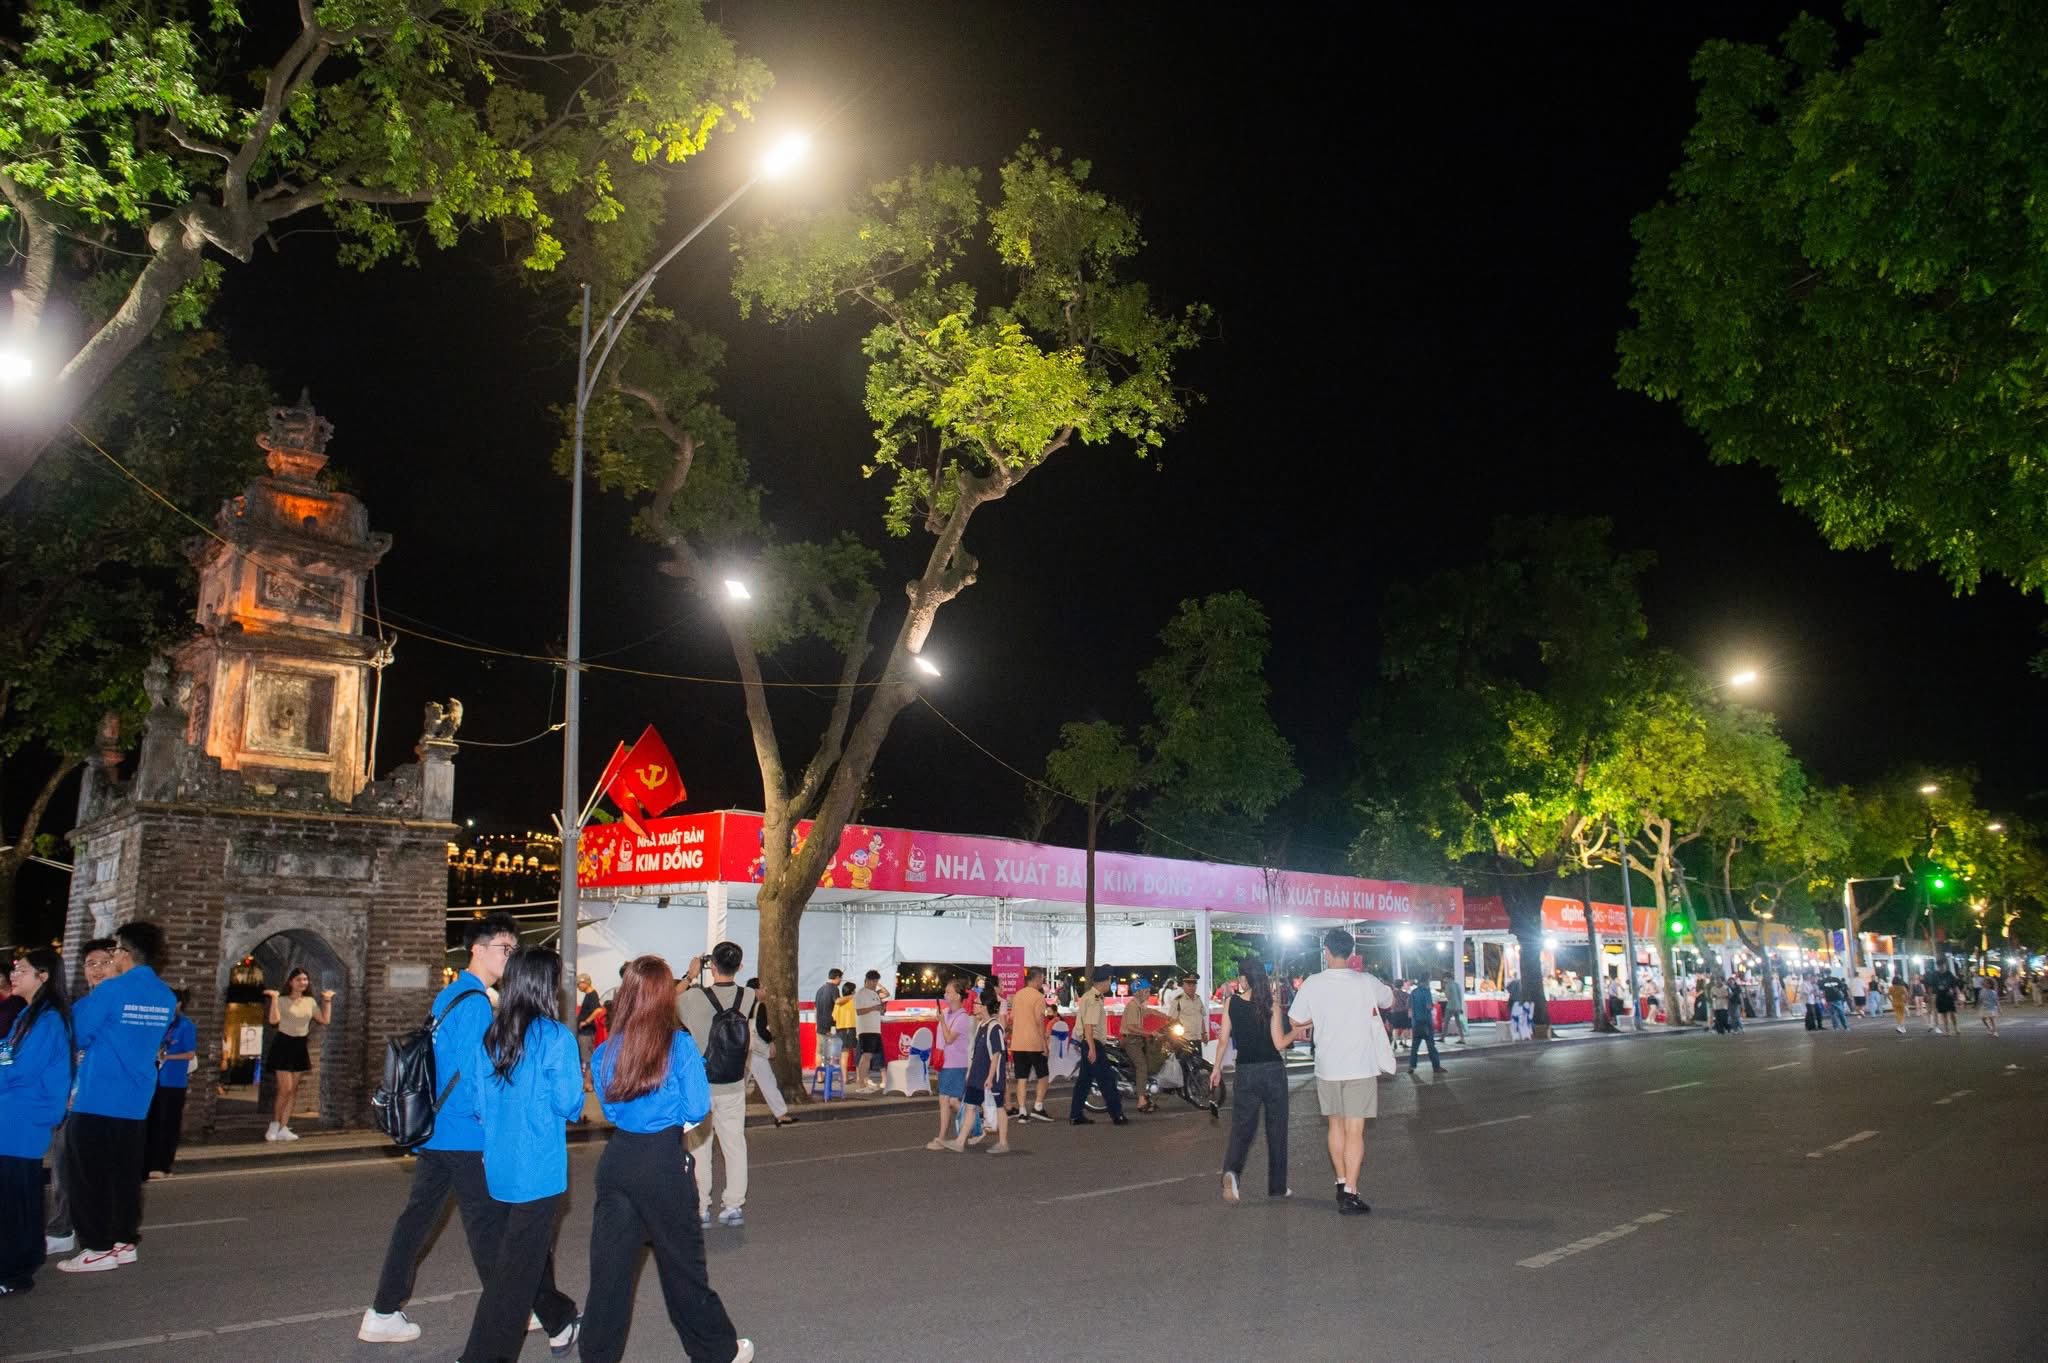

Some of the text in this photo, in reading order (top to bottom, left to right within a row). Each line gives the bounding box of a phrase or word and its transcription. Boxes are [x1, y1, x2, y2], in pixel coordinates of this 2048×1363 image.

[658, 827, 683, 846] XUẤT
[683, 826, 704, 844] BẢN
[635, 853, 660, 872] KIM
[662, 845, 704, 871] ĐỒNG
[935, 850, 986, 881] NHÀ
[993, 856, 1050, 886] XUẤT
[1103, 869, 1137, 893] KIM
[1324, 885, 1350, 909] BẢN
[1353, 891, 1375, 910] KIM
